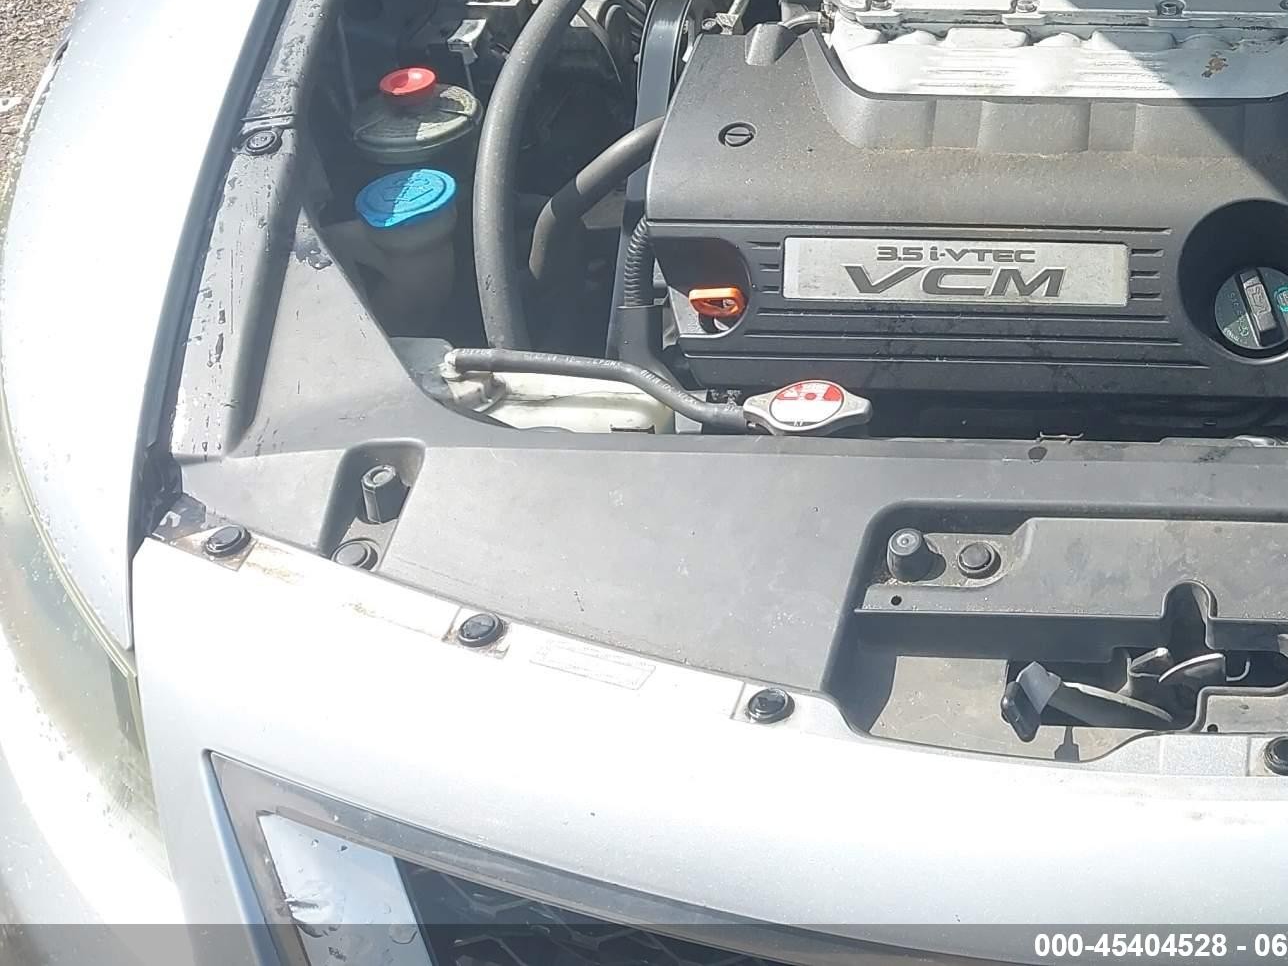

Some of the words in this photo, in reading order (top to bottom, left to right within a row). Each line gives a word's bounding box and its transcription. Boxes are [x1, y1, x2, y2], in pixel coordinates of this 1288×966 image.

[876, 246, 923, 261] 3.5
[929, 246, 1036, 263] i-VTEC
[842, 264, 1067, 298] VCM
